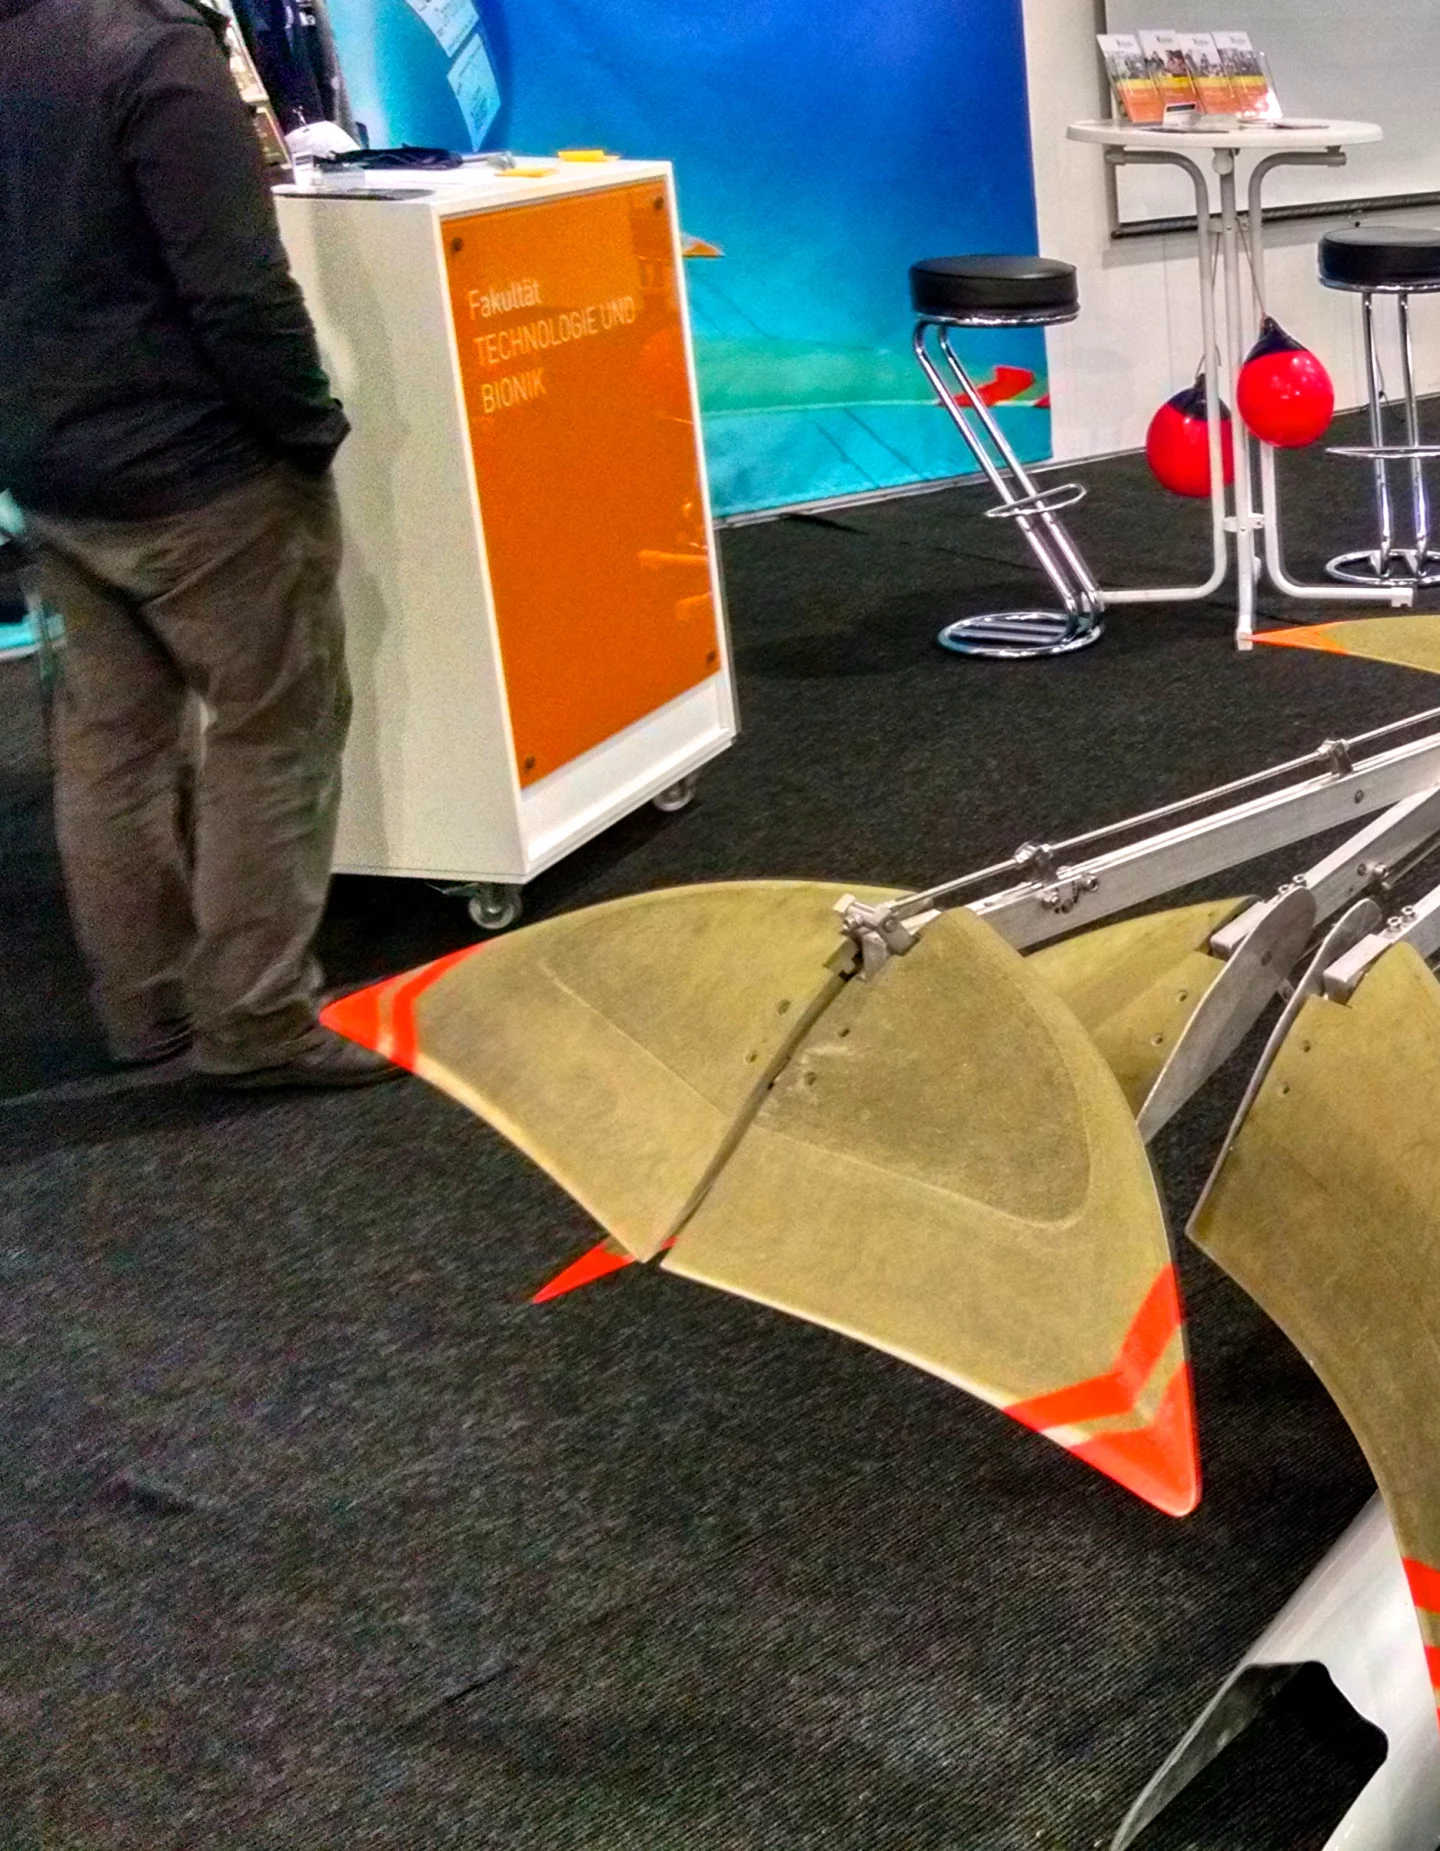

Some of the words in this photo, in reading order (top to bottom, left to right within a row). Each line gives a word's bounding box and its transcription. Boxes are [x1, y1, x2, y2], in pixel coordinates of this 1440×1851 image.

[468, 278, 542, 320] Fakultät
[473, 306, 598, 366] TECHNOLOGIE
[600, 296, 637, 330] UND
[481, 368, 548, 414] BIONIK
